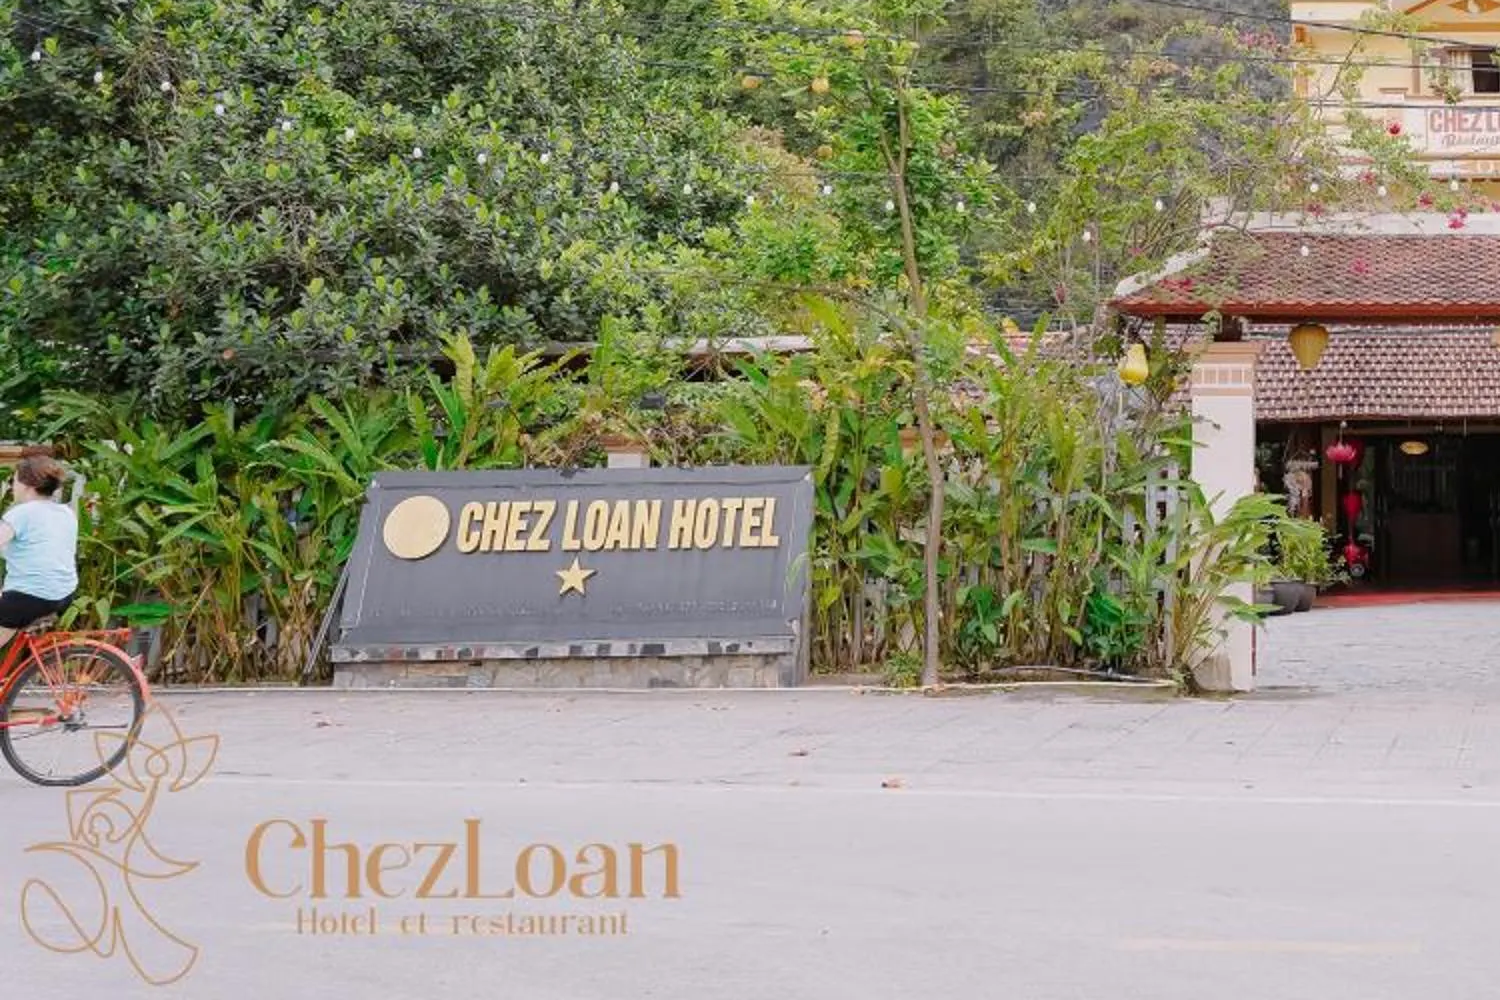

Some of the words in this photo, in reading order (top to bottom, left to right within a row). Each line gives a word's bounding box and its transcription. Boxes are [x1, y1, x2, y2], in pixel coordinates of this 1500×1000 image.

[1429, 108, 1482, 132] CHEZ
[456, 500, 556, 552] CHEZ
[562, 499, 662, 551] LOAN
[668, 497, 780, 549] HOTEL
